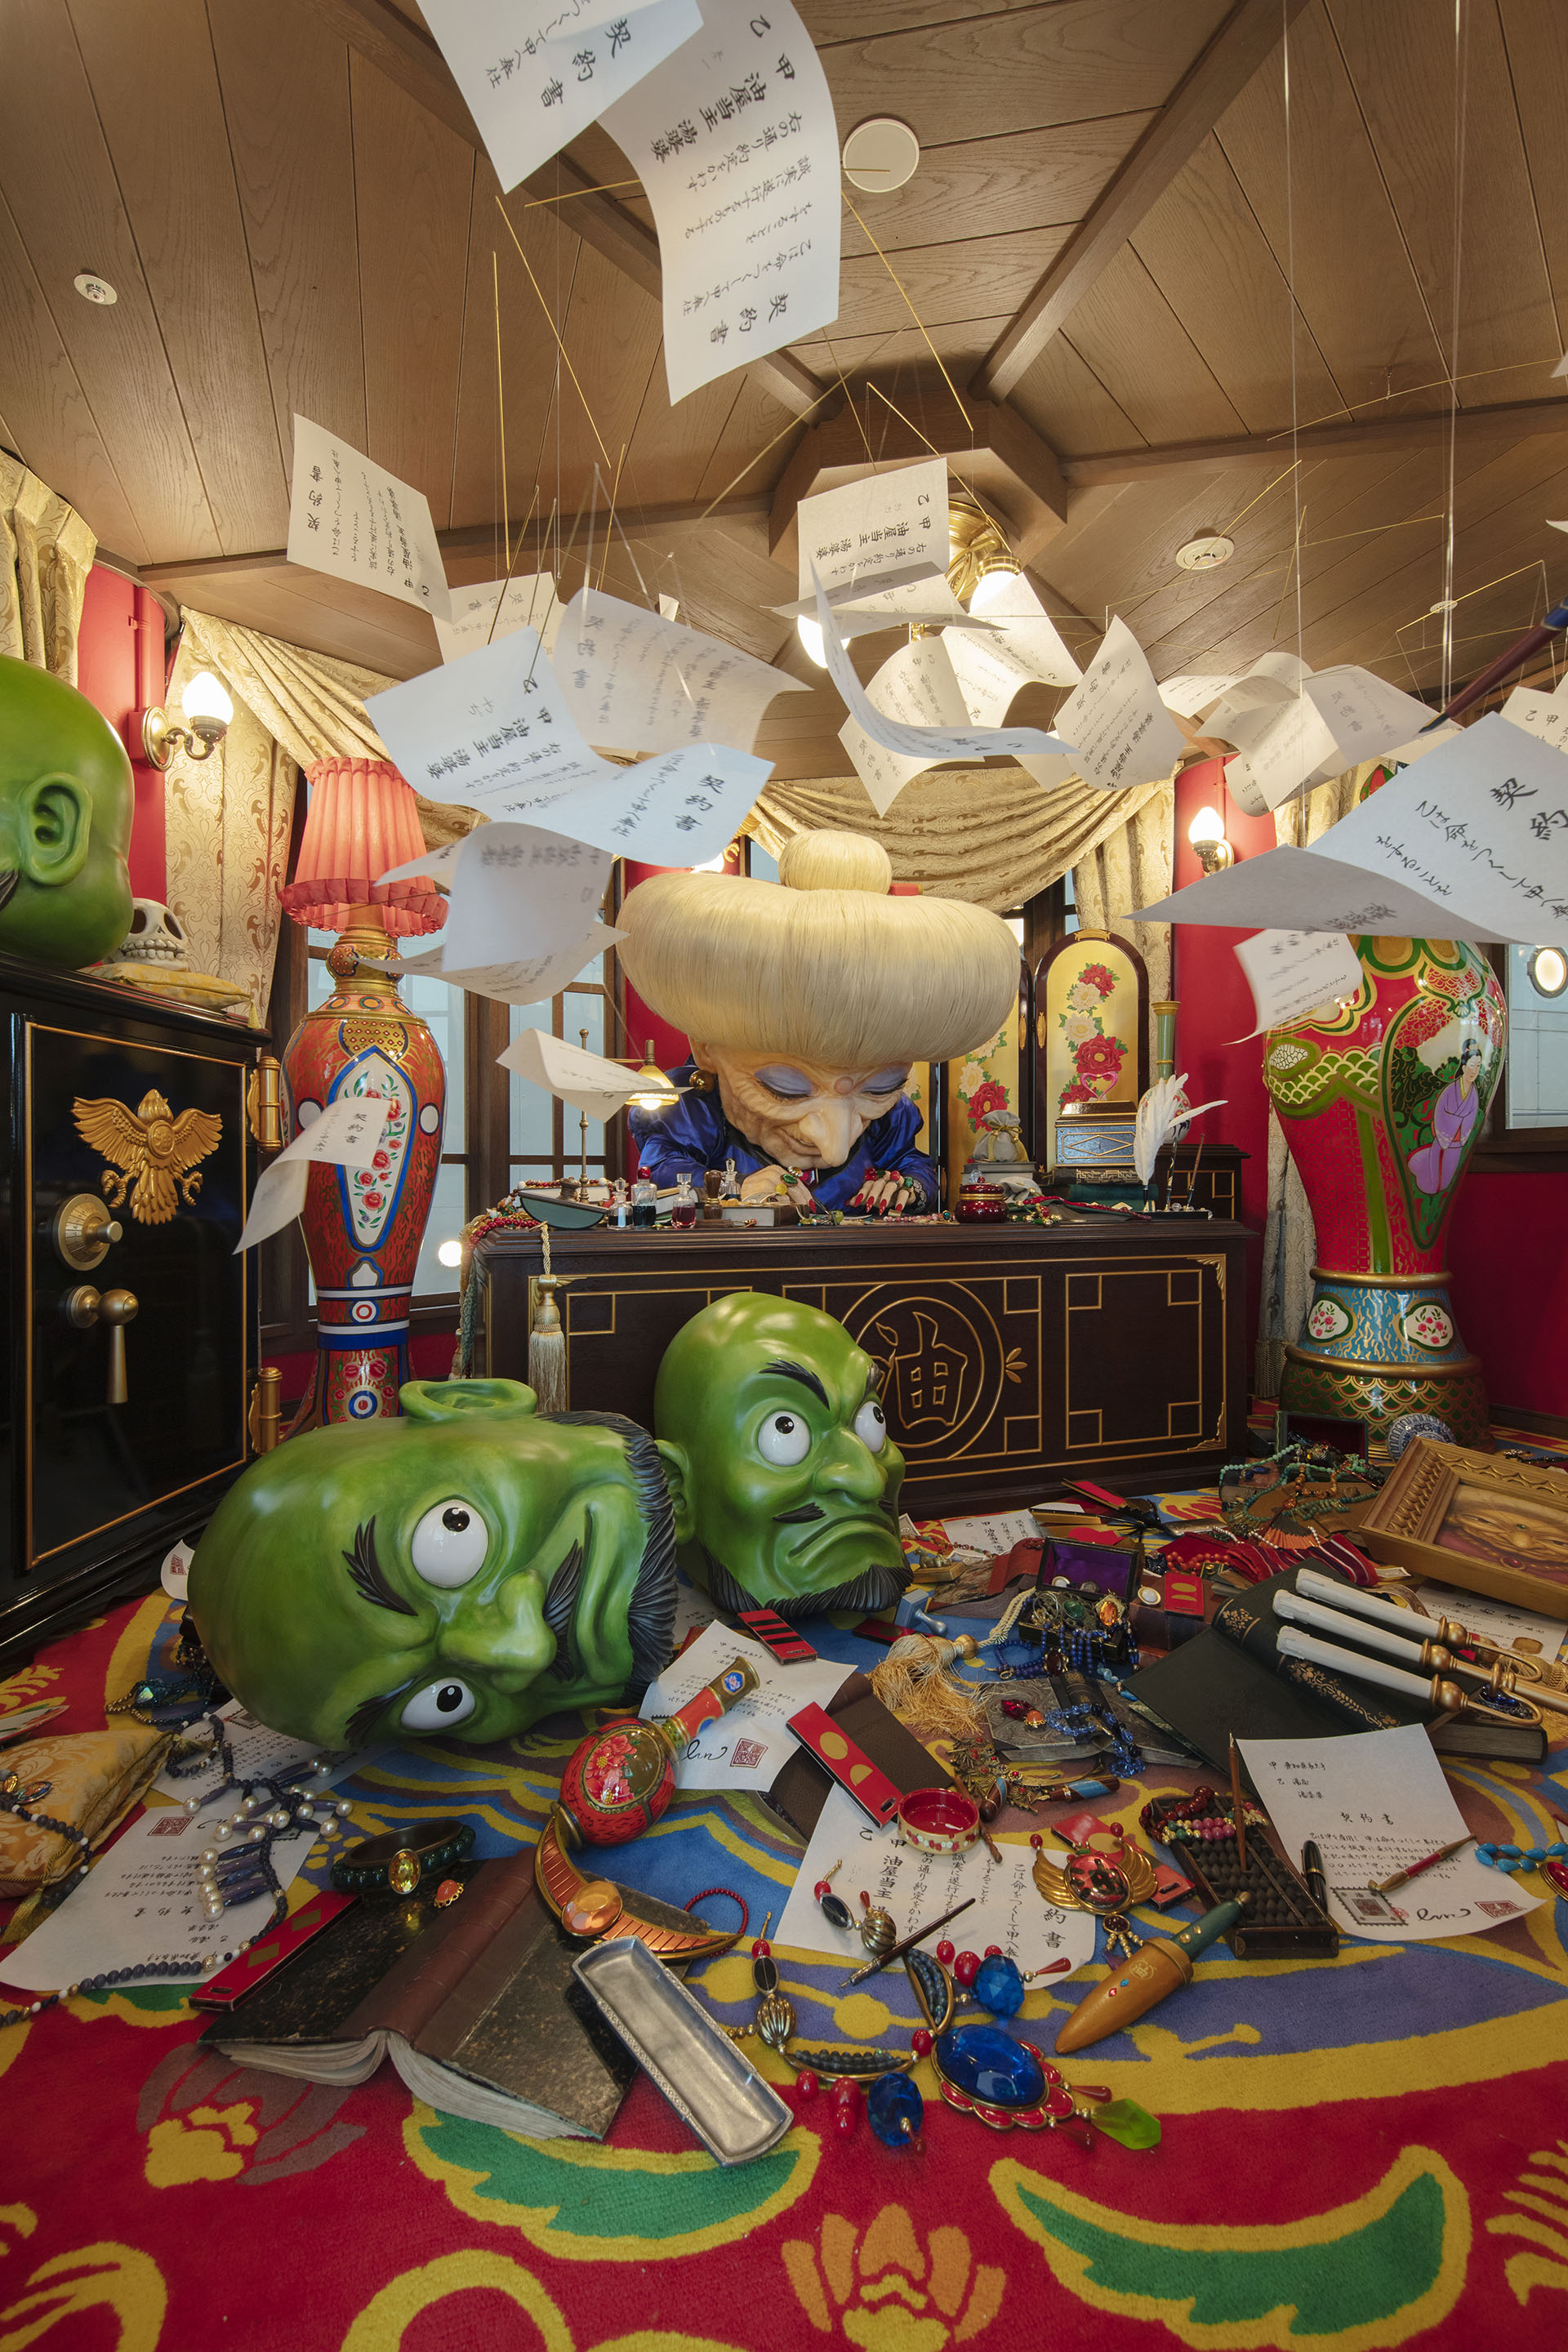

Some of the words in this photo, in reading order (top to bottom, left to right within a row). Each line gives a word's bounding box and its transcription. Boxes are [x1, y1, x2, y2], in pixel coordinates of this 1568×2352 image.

[750, 16, 771, 38] 乙
[541, 19, 631, 107] 契約書
[776, 54, 795, 79] 甲
[699, 73, 766, 132] 油屋当主
[710, 294, 788, 344] 契約書
[307, 466, 323, 532] 契約書
[918, 494, 929, 506] 乙
[919, 516, 931, 529] 甲
[859, 523, 909, 546] 油屋当主
[404, 578, 413, 588] 甲
[421, 586, 429, 596] 乙
[1076, 662, 1111, 710] 契約書
[537, 708, 551, 723] 甲
[1526, 710, 1537, 721] 乙
[1547, 715, 1558, 725] 甲
[675, 775, 724, 831] 契約書
[1376, 836, 1451, 895] をすることを
[1341, 1812, 1393, 1825] 契約書
[859, 1827, 873, 1841] 乙
[891, 1839, 907, 1847] 甲
[874, 1855, 902, 1900] 油屋当主
[980, 1858, 997, 1904] をすることを
